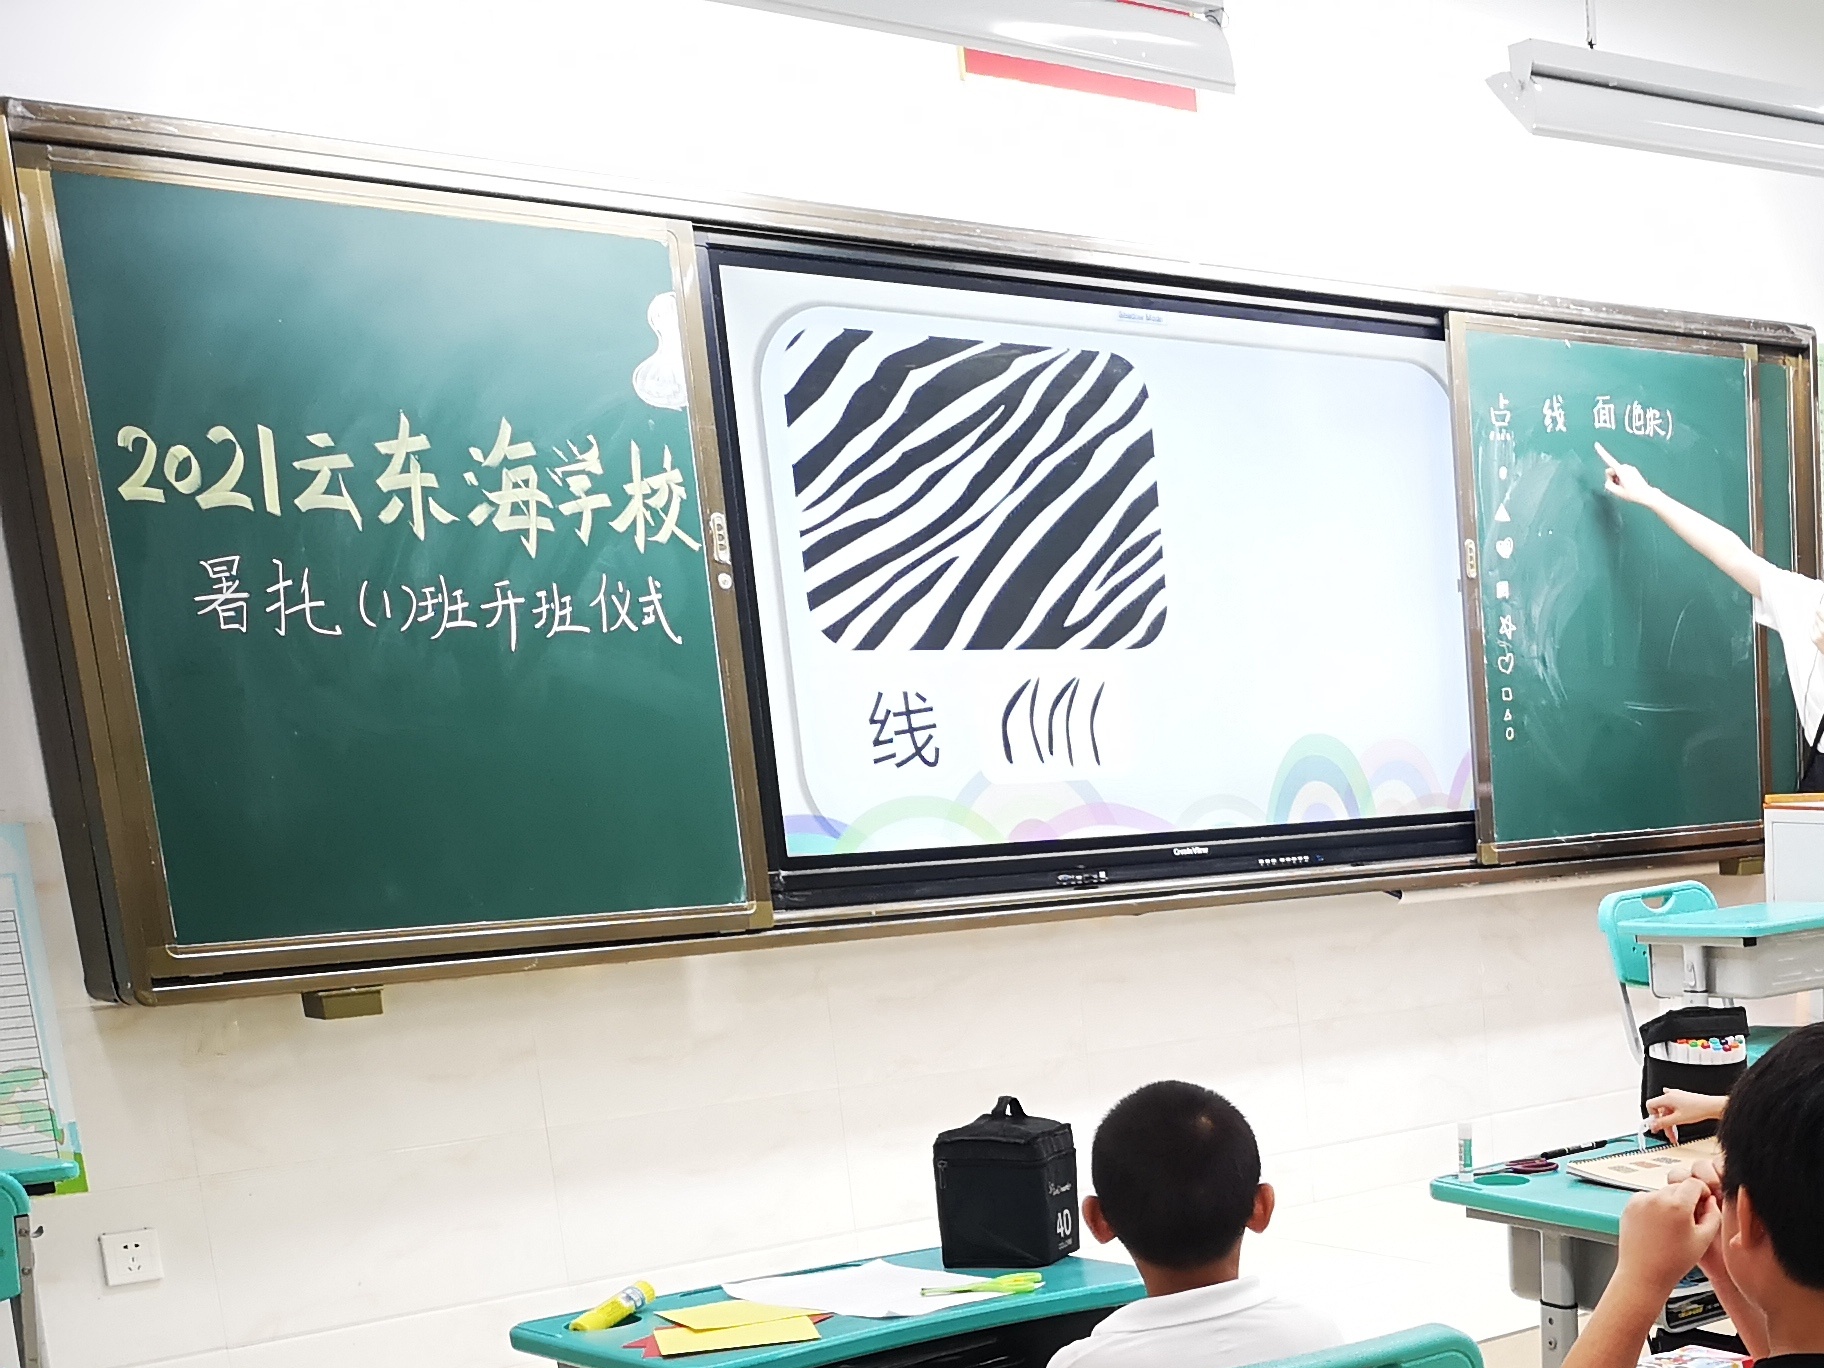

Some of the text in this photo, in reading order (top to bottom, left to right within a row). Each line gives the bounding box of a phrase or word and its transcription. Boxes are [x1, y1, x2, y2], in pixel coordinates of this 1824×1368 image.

[1488, 392, 1511, 441] 点
[1542, 394, 1567, 433] 线
[115, 408, 702, 558] 2021云东海学校
[869, 691, 940, 769] 线
[1057, 1208, 1072, 1238] 40
